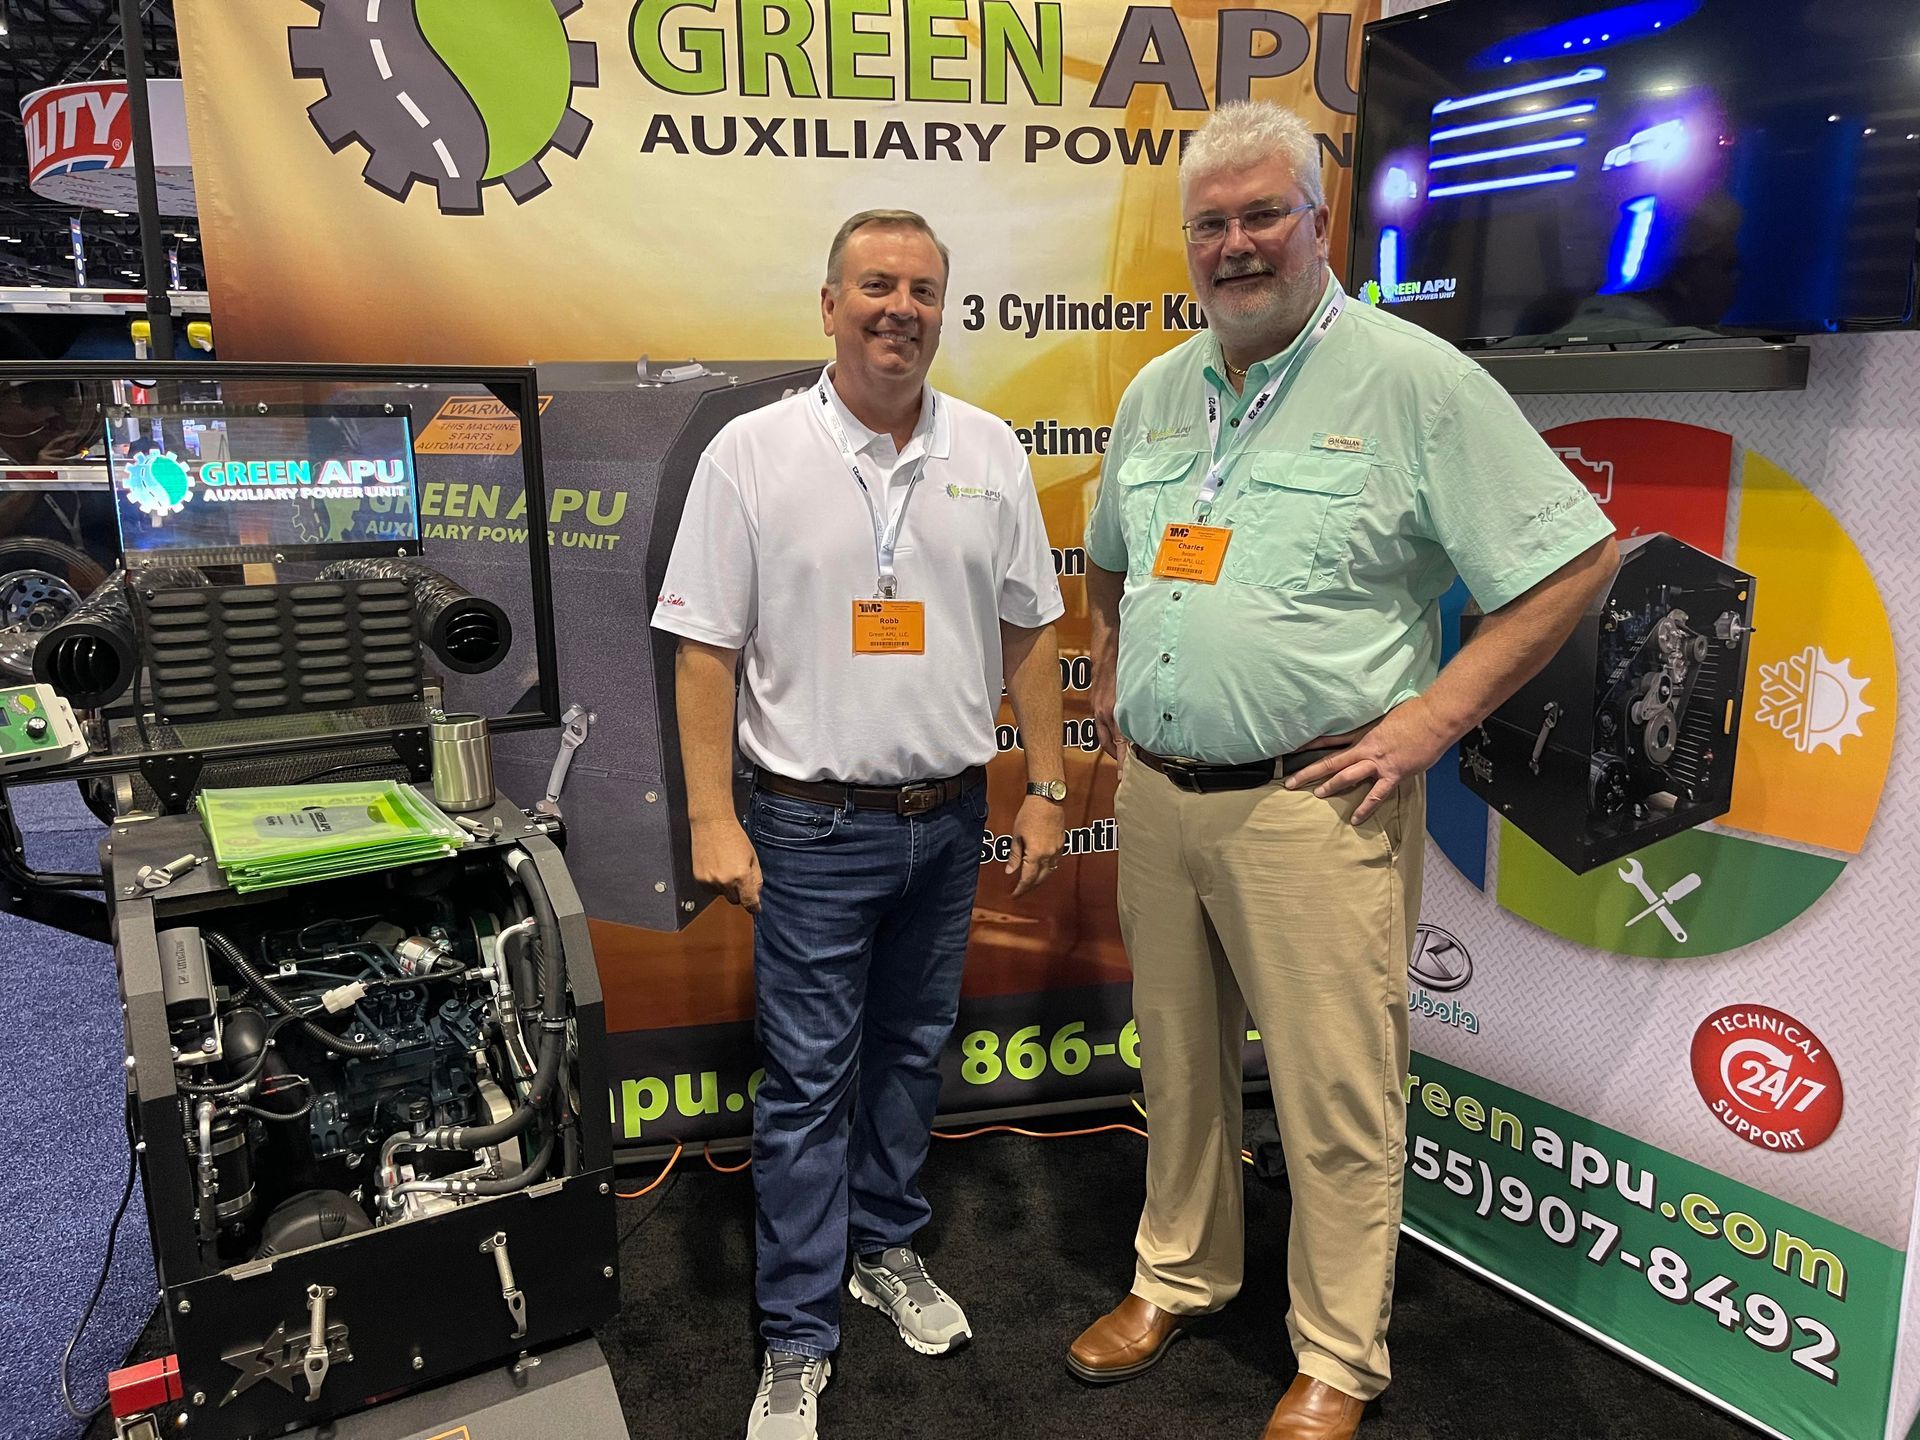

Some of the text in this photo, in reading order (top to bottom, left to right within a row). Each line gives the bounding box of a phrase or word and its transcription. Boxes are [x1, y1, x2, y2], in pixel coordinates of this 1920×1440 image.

[628, 0, 1063, 106] GREEN
[639, 113, 1198, 167] AUXILIARY POW
[1383, 278, 1457, 296] GREEN APU
[1415, 293, 1438, 302] POWER
[1439, 291, 1456, 299] UNIT
[962, 293, 1210, 339] 3 Cylinder Ku
[416, 441, 514, 451] AUTOMATICALLY
[440, 422, 519, 432] THIS MACHINE
[448, 432, 494, 441] STARTS
[200, 458, 404, 487] GREEN APU
[203, 484, 406, 502] AUXILIARY POWER UNIT
[365, 520, 620, 550] AUXIIARY POWR UNIT
[1178, 542, 1204, 551] Charles
[1408, 988, 1479, 1034] ubota
[1711, 1012, 1821, 1063] TECHNICAL
[1736, 1059, 1827, 1113] 24/7
[1711, 1099, 1806, 1149] SUPPORT
[1403, 1073, 1848, 1299] reenapu.com
[1404, 1135, 1839, 1382] 55)907-8492
